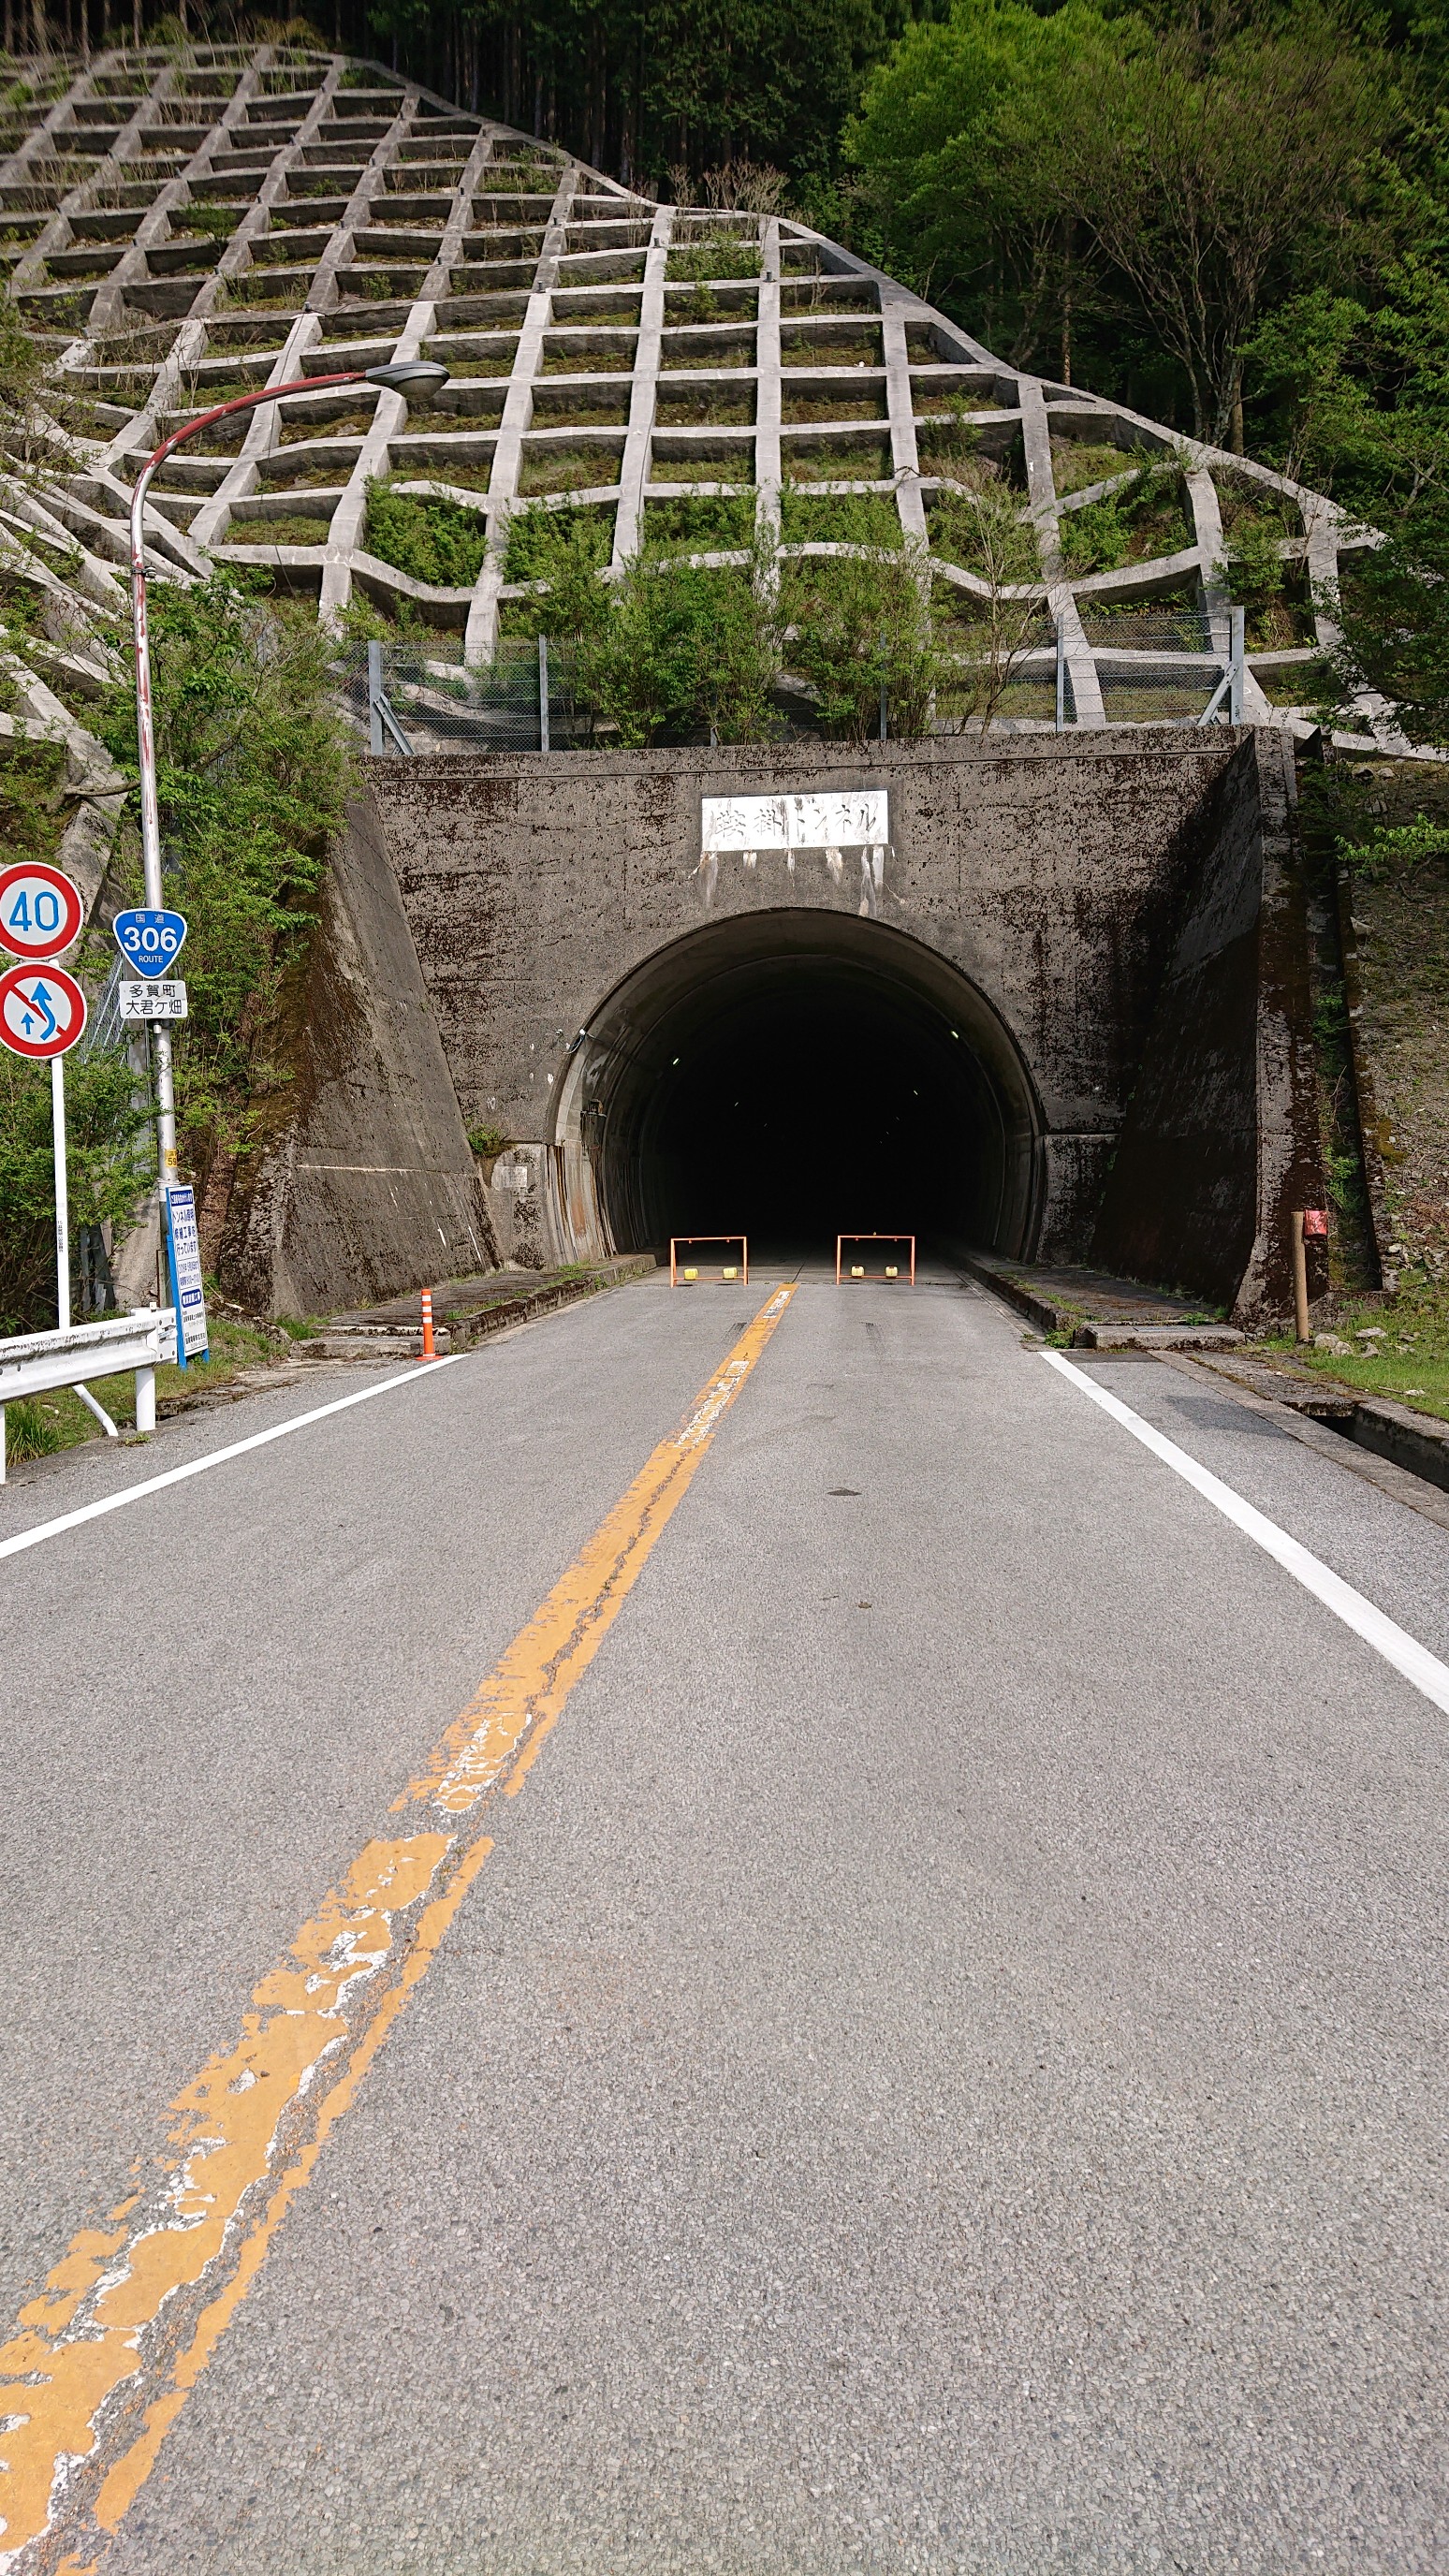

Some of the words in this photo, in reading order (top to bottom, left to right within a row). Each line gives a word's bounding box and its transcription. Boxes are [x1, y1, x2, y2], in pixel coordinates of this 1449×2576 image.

[8, 891, 60, 931] 40
[135, 914, 166, 925] 国道
[124, 927, 178, 952] 306
[139, 955, 164, 963] ROUTE
[129, 984, 177, 999] 多賀町
